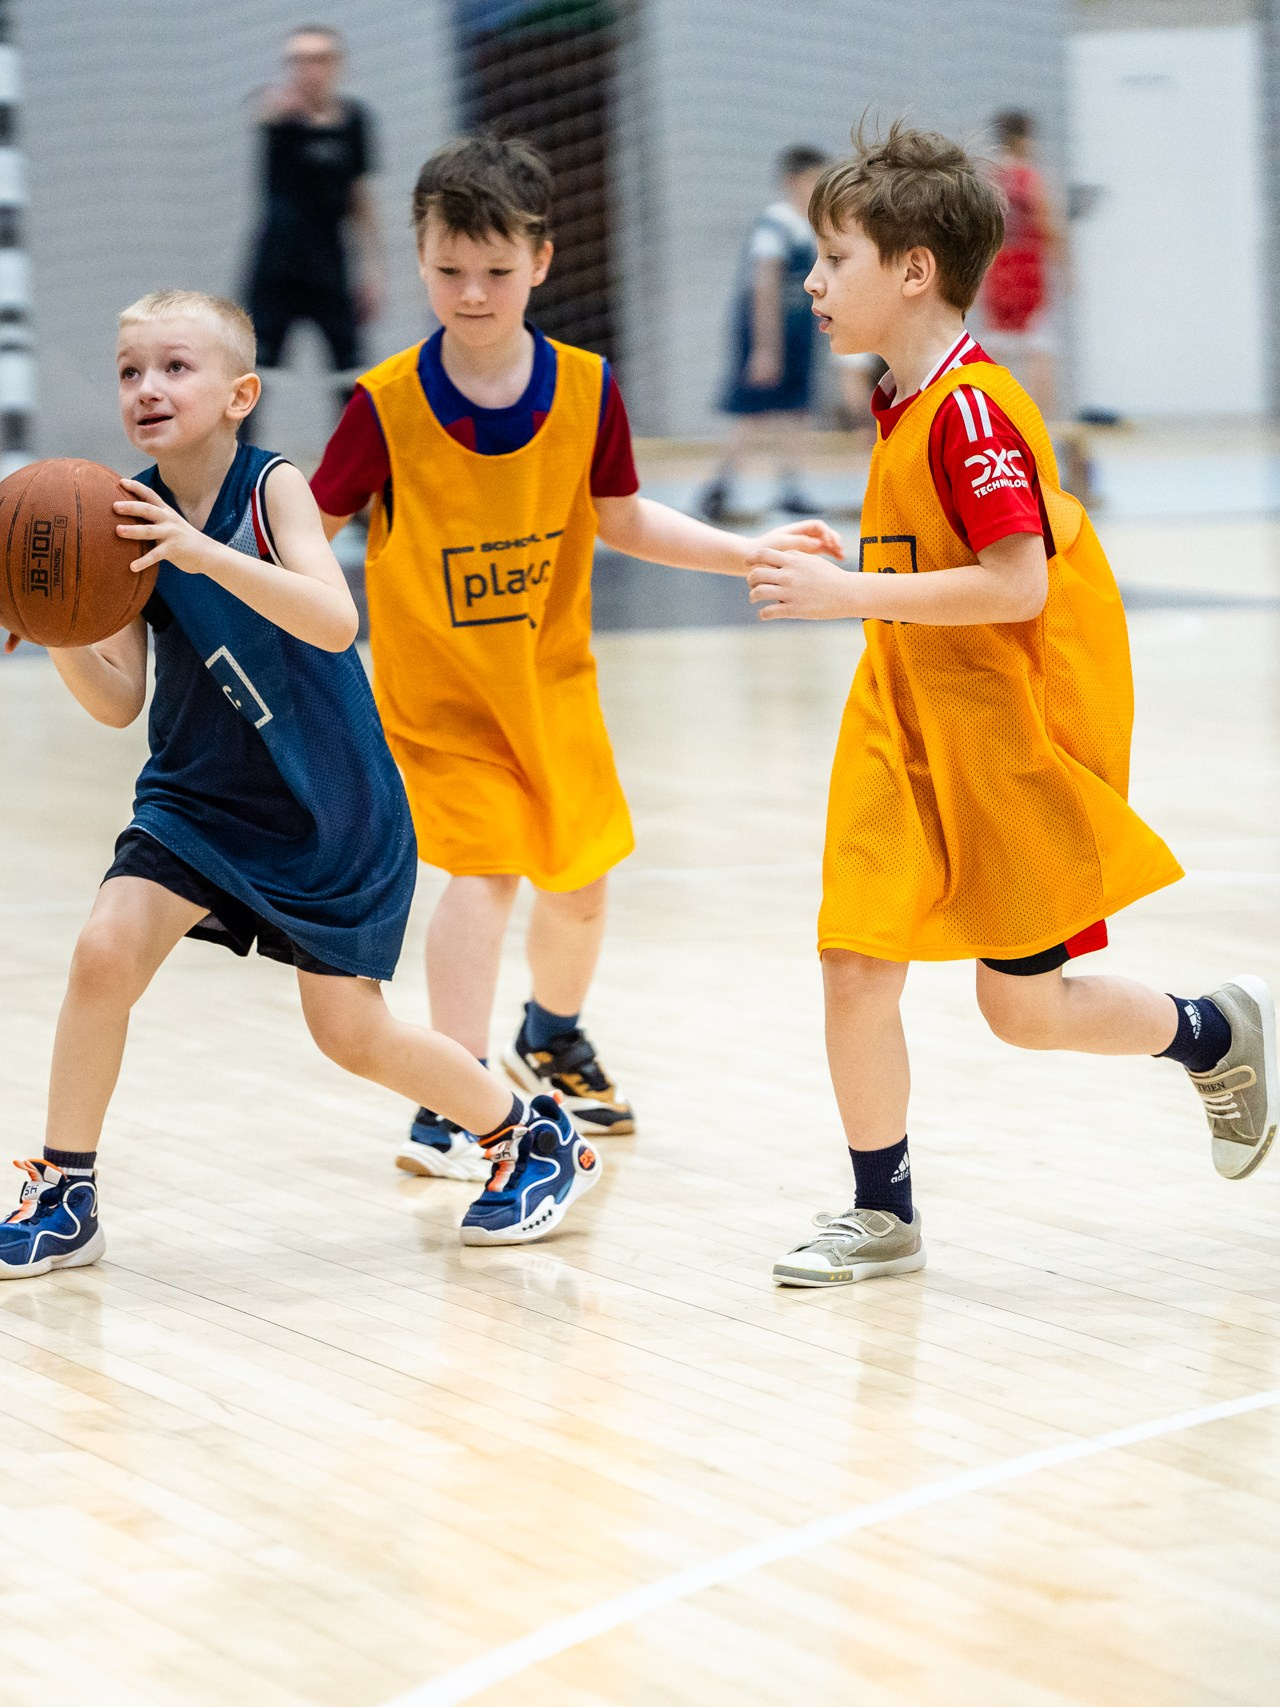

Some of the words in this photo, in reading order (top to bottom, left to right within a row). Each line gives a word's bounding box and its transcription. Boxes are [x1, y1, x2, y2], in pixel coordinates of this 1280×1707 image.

[964, 448, 1026, 488] DXC
[973, 479, 1029, 498] TECHNOLOG
[30, 520, 52, 598] JB-100
[53, 548, 62, 587] TRAINING
